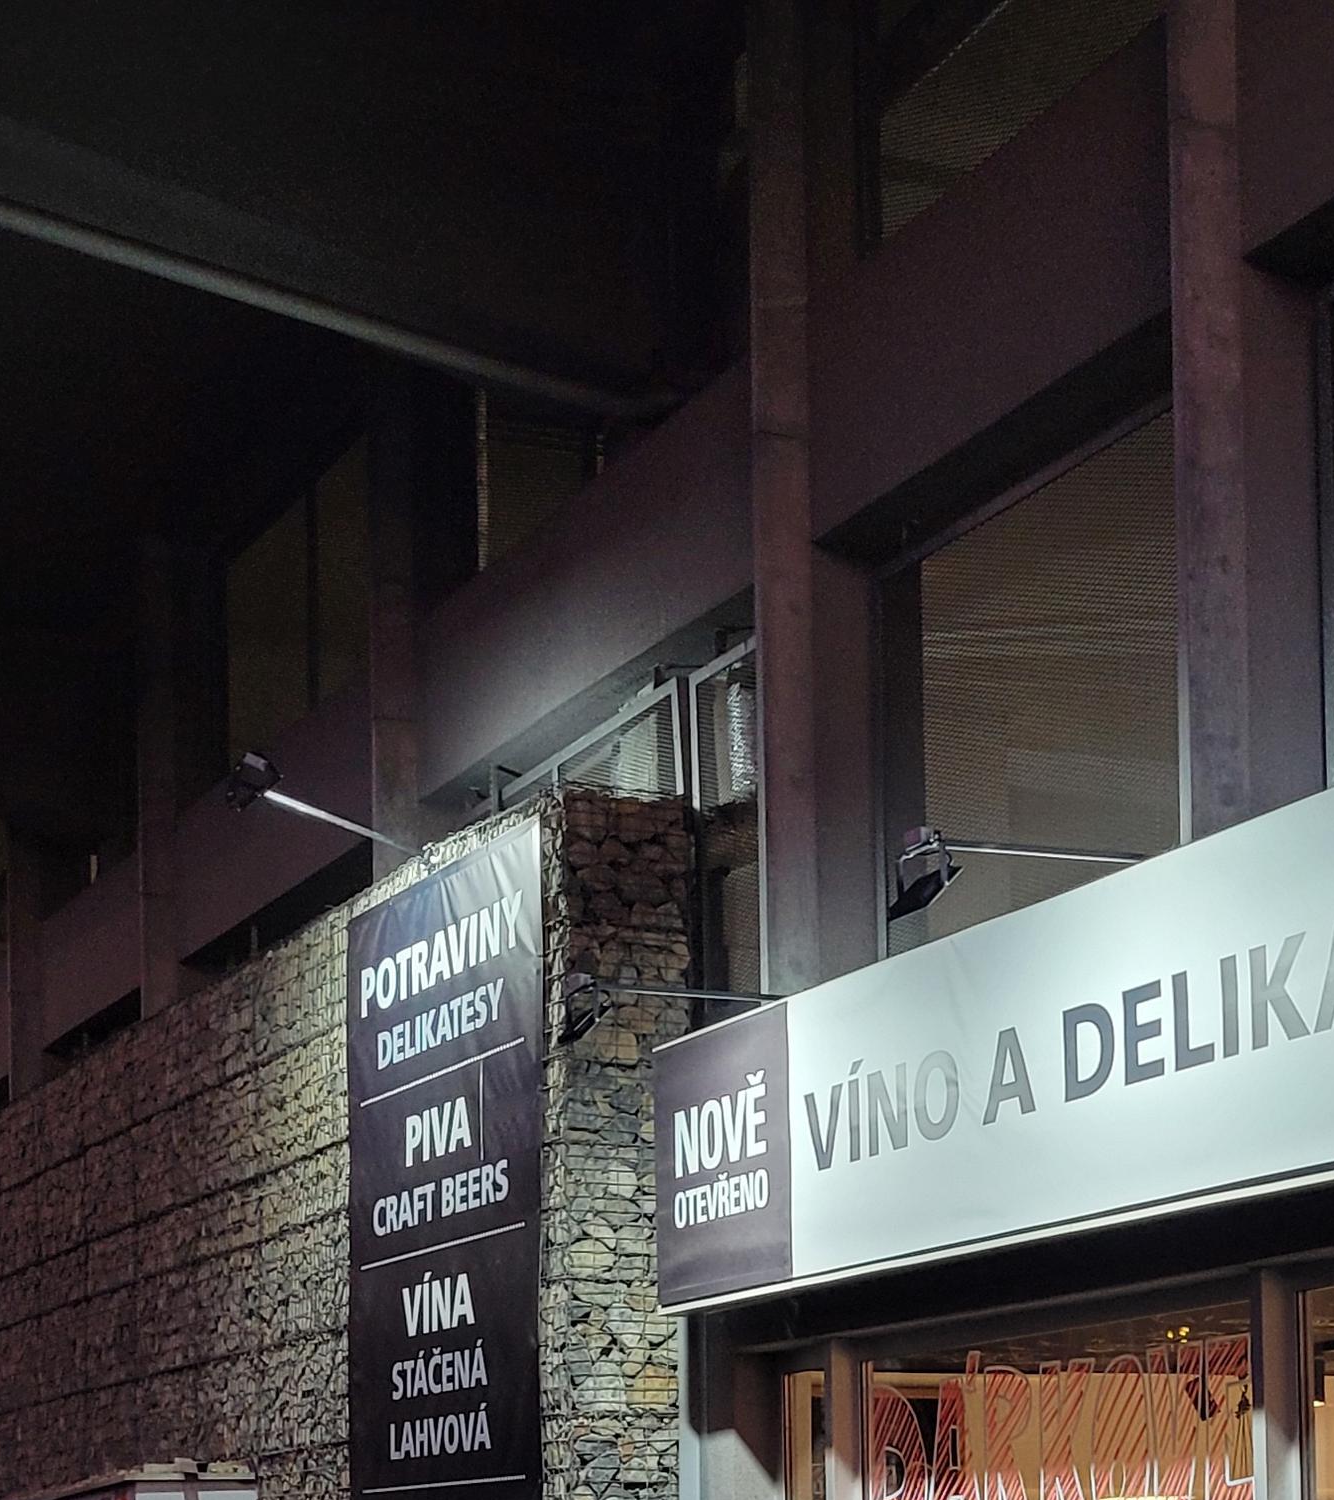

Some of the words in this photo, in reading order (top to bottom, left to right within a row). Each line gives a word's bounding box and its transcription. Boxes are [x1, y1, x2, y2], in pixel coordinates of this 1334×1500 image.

[361, 889, 525, 1018] POTRAVINY
[377, 977, 505, 1071] DELIKATESY
[405, 1095, 473, 1168] PIVA
[672, 1069, 768, 1179] NOVĚ
[803, 1058, 960, 1171] VÍNO
[982, 1026, 1037, 1126] A
[372, 1182, 436, 1238] CRAFT
[440, 1159, 510, 1218] BEERS
[674, 1168, 769, 1230] OTEVŘENO
[402, 1271, 475, 1339] VÍNA
[391, 1338, 488, 1402] STÁČENÁ
[389, 1403, 492, 1461] LAHVOVÁ
